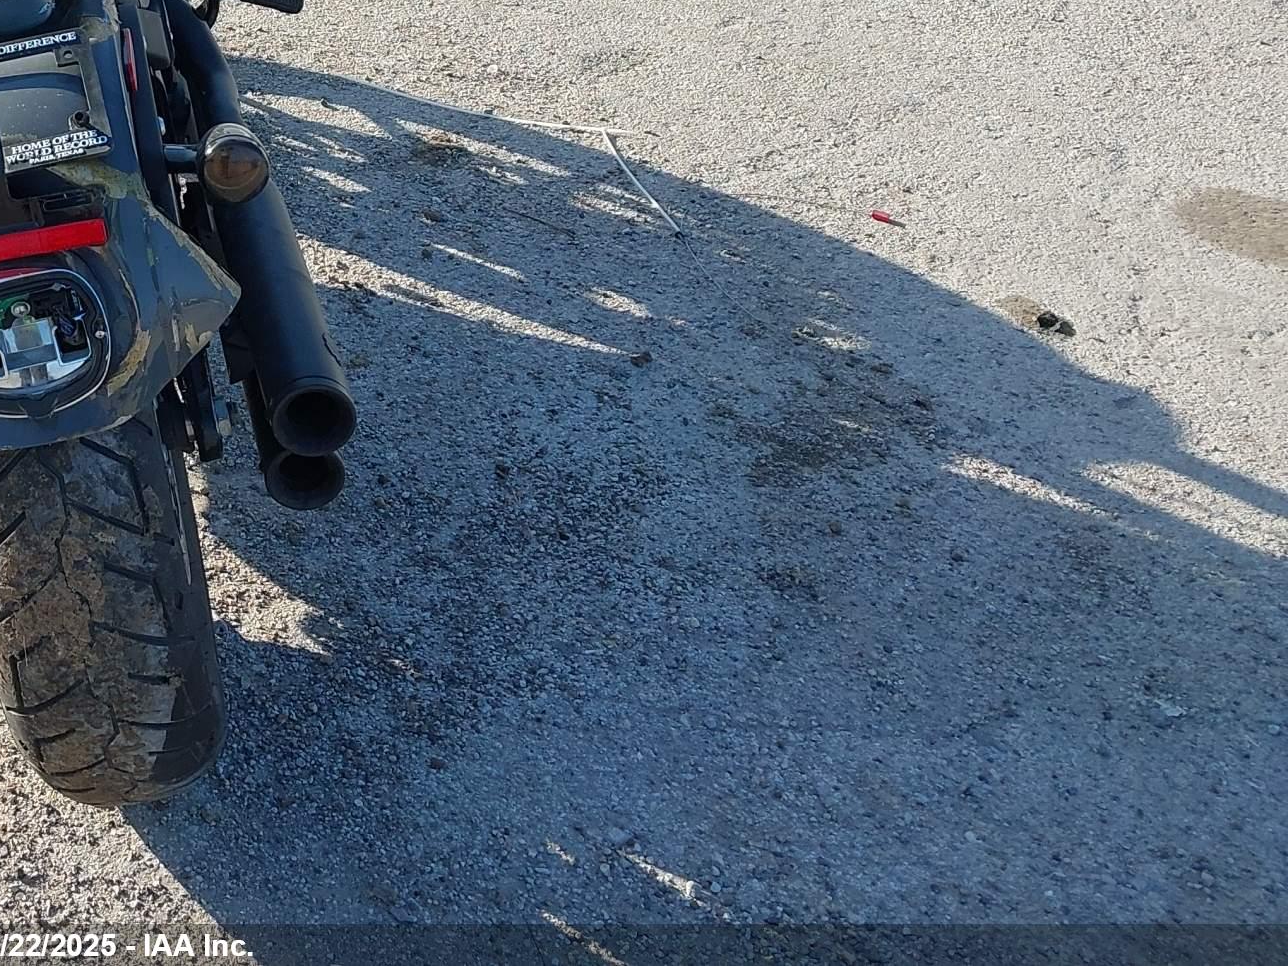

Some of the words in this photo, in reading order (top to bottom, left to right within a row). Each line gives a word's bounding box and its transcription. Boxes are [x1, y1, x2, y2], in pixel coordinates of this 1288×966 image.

[5, 147, 52, 165] WORLD
[54, 136, 108, 154] RECORD
[12, 139, 51, 155] HOME
[52, 134, 69, 145] OF
[70, 130, 98, 140] THE
[56, 148, 84, 160] TEXAS
